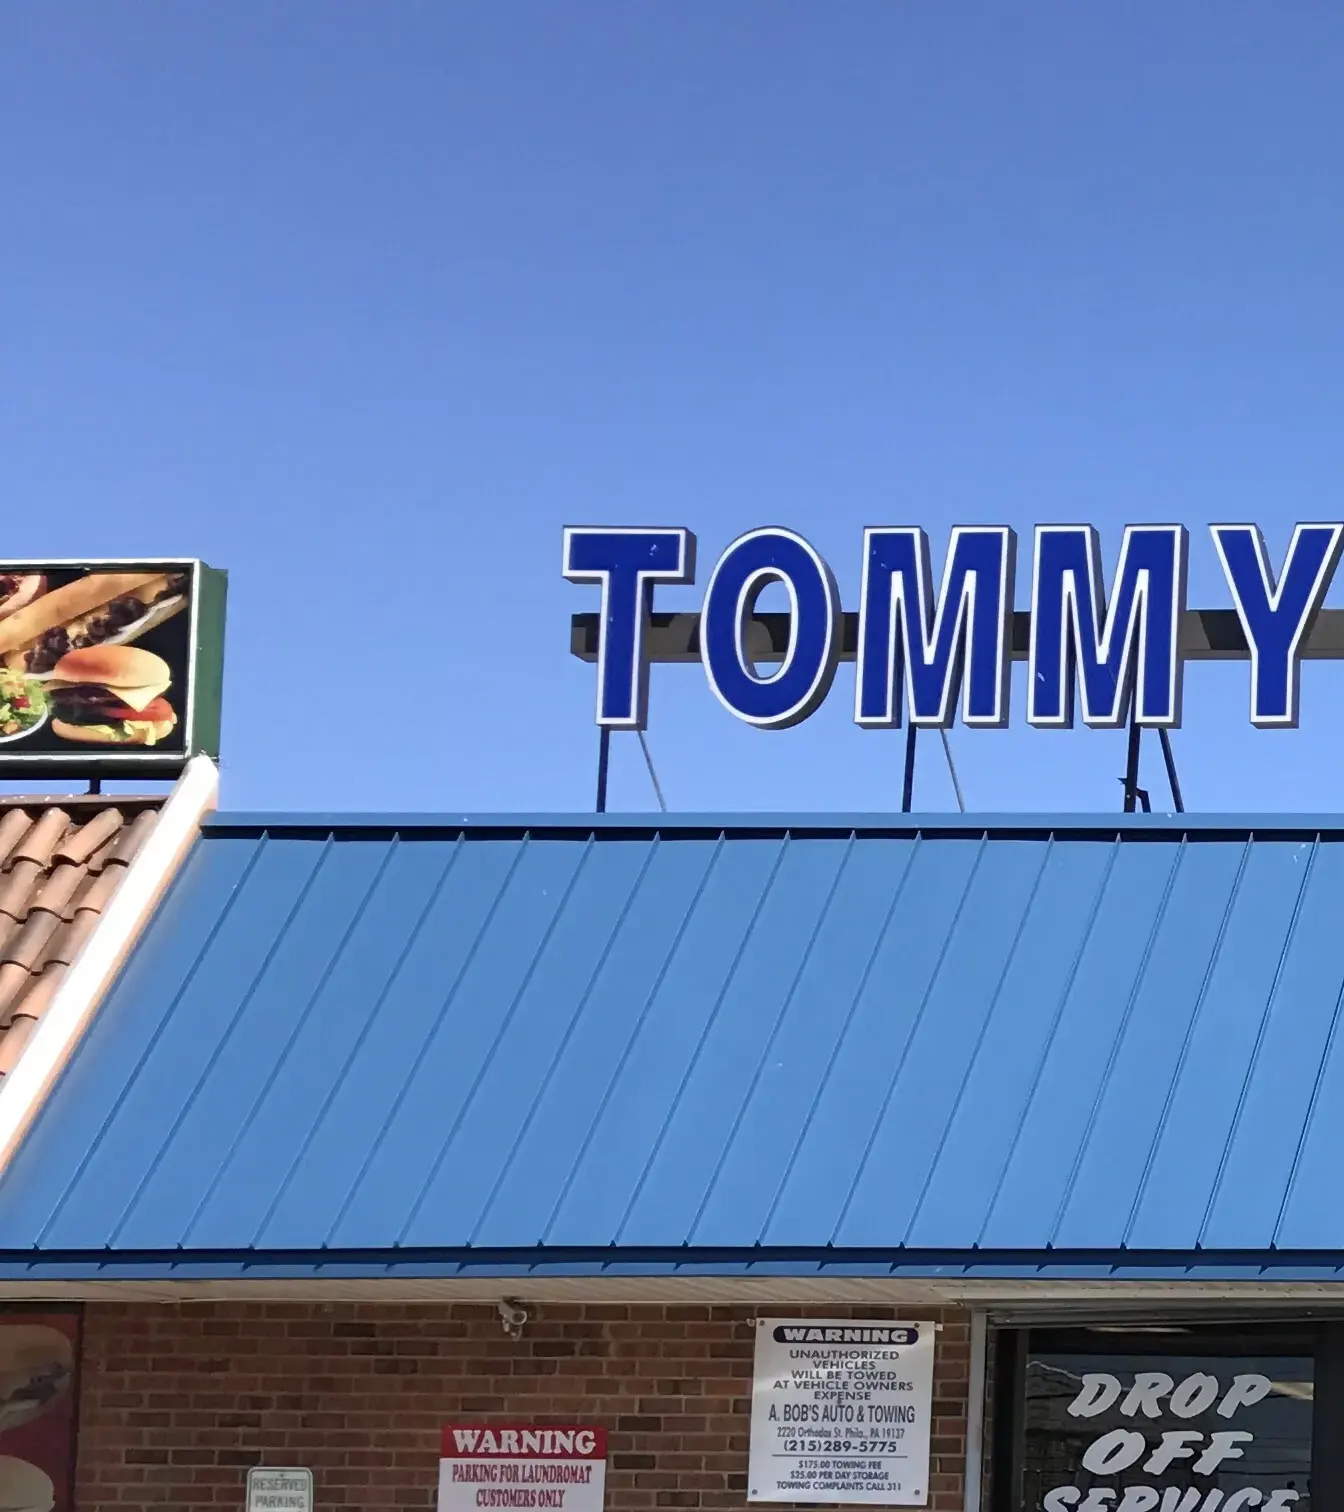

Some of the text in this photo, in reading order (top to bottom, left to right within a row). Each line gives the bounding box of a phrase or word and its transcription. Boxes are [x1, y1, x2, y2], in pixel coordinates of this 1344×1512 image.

[783, 1328, 908, 1343] WARNING
[789, 1350, 900, 1361] UNAUTHORIZED
[812, 1361, 876, 1370] VEHICLES
[791, 1370, 897, 1380] WILL BE TOWED
[773, 1380, 913, 1391] AT VEHICLE OWNERS
[813, 1391, 872, 1401] EXPENSE
[1066, 1372, 1273, 1419] DROP
[768, 1404, 916, 1424] A. BOB'S AUTO & TOWING
[777, 1427, 796, 1438] 2220
[870, 1428, 881, 1439] PA
[882, 1428, 905, 1439] 19137
[452, 1430, 597, 1454] WARNING
[783, 1440, 897, 1453] (215)289-5775
[1081, 1428, 1254, 1476] OFF
[832, 1461, 867, 1470] TOWING
[868, 1461, 882, 1470] FEE
[452, 1464, 592, 1484] PARKING FOR LAUNDROMAT
[818, 1471, 833, 1480] PER
[834, 1471, 851, 1480] DAY
[852, 1471, 889, 1481] STORAGE
[252, 1479, 308, 1491] RESERVED
[776, 1481, 811, 1490] TOWING
[812, 1481, 864, 1491] COMPLAINTS
[865, 1482, 886, 1491] CALL
[255, 1495, 305, 1508] PARKING
[475, 1488, 566, 1508] CUSTOMERS ONLY
